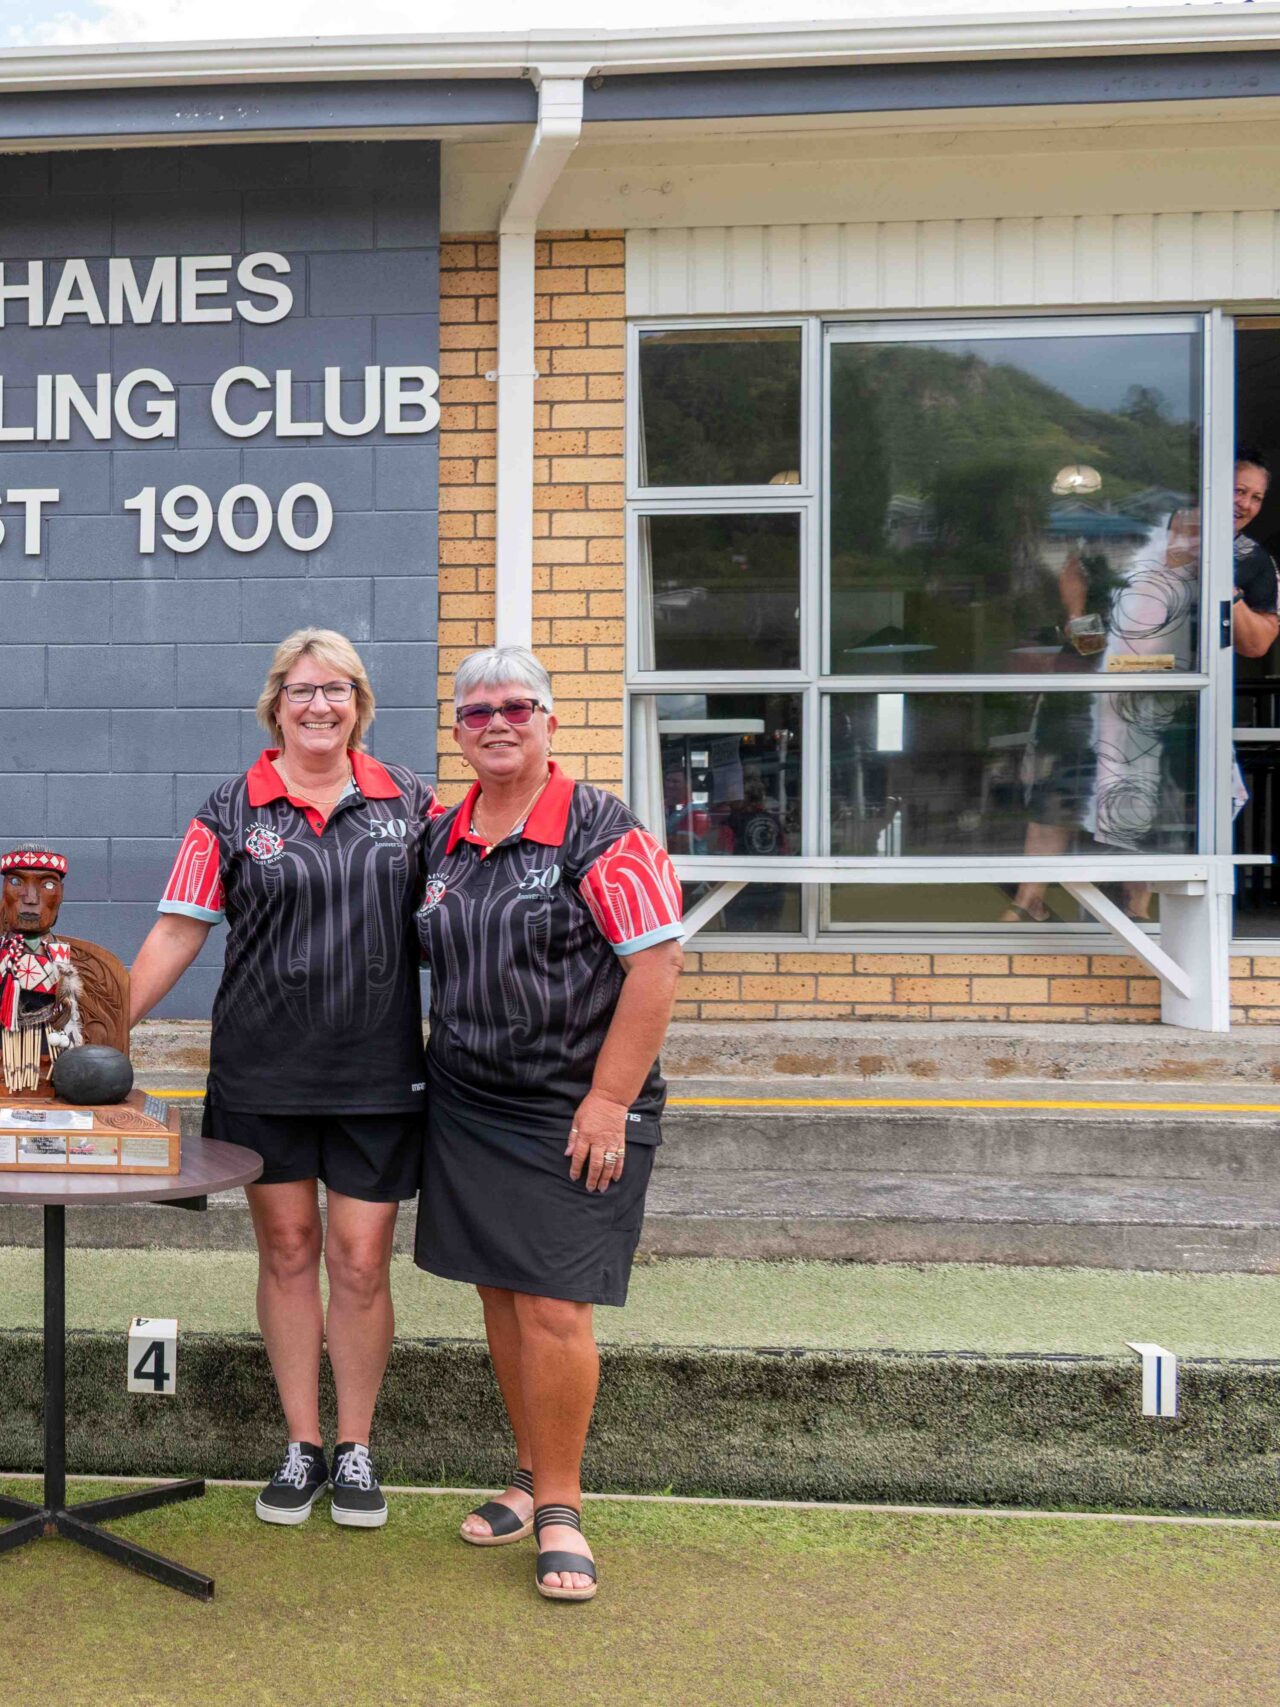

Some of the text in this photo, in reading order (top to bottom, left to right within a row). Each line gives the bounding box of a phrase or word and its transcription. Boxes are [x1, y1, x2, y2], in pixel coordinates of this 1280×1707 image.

[210, 365, 441, 438] CLUB
[124, 481, 333, 554] 1900
[244, 821, 277, 833] TAINUI
[427, 872, 450, 881] AINUI
[133, 1341, 170, 1392] 4
